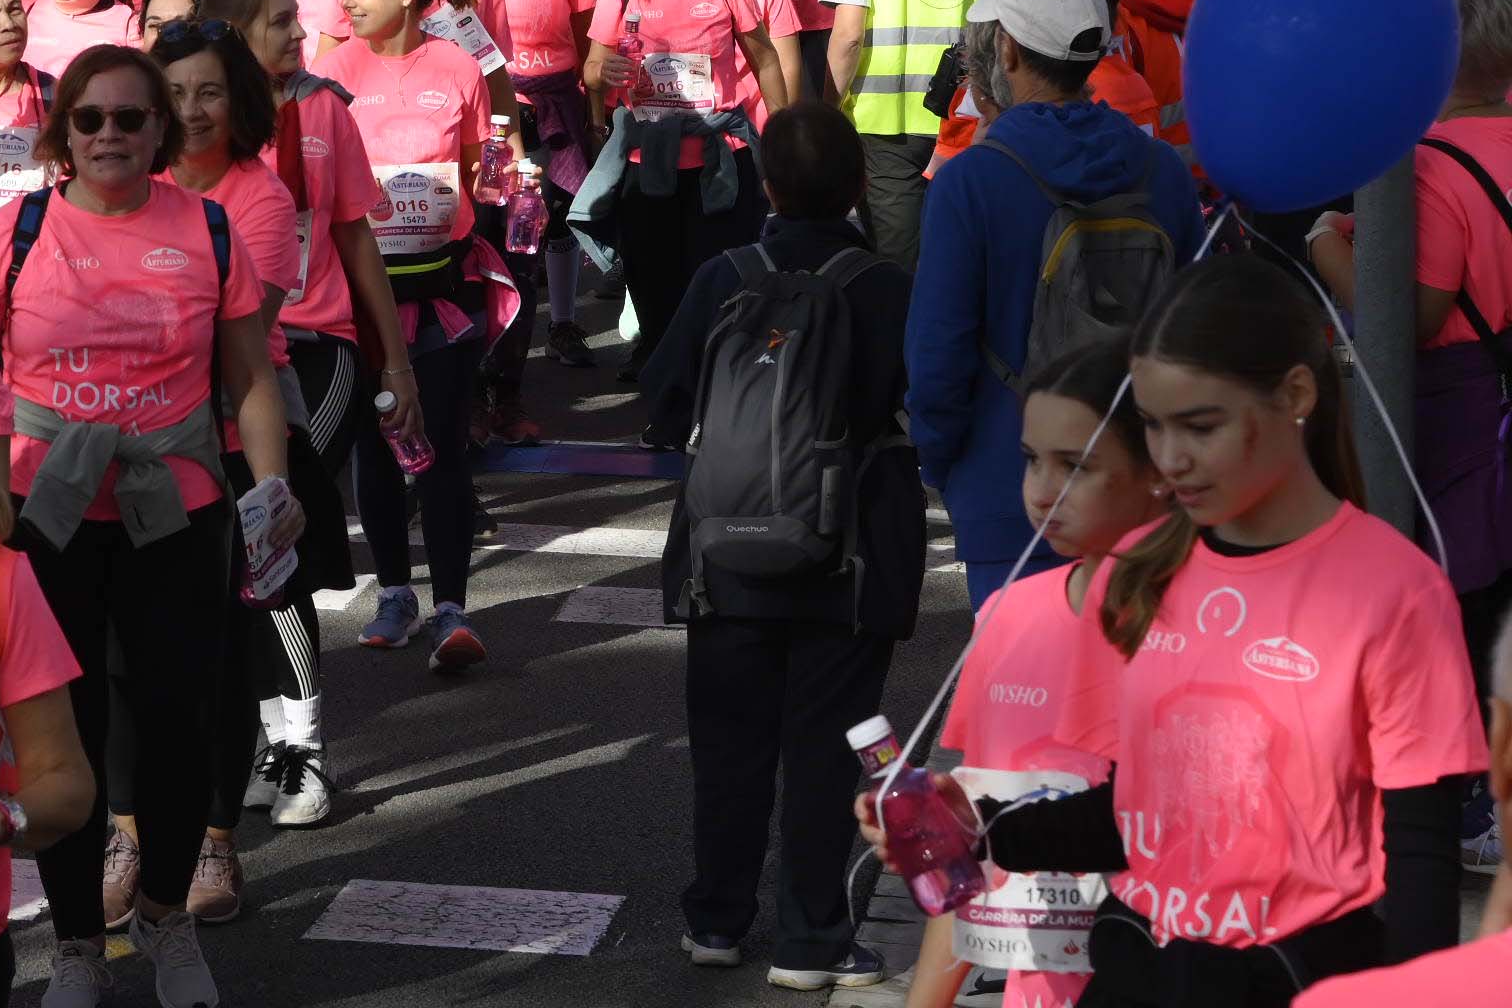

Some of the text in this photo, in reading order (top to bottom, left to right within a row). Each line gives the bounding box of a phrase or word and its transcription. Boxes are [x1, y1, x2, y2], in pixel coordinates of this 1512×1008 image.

[507, 51, 553, 70] RSAL
[656, 80, 685, 94] 016
[349, 95, 385, 107] YSHO
[391, 179, 427, 190] ASTURIANA
[395, 199, 429, 213] 016
[401, 216, 427, 224] 15479
[54, 247, 101, 270] OSHO
[48, 347, 90, 373] TU
[52, 380, 173, 411] DORSAL
[726, 525, 769, 533] Quechua
[1142, 630, 1187, 654] SHO
[989, 682, 1048, 708] OYSHO
[1119, 810, 1162, 860] TU
[1025, 887, 1081, 906] 17310
[967, 907, 1029, 926] CARRERA
[1029, 913, 1048, 926] DE
[1049, 914, 1066, 927] LA
[965, 934, 1030, 954] OYSHO
